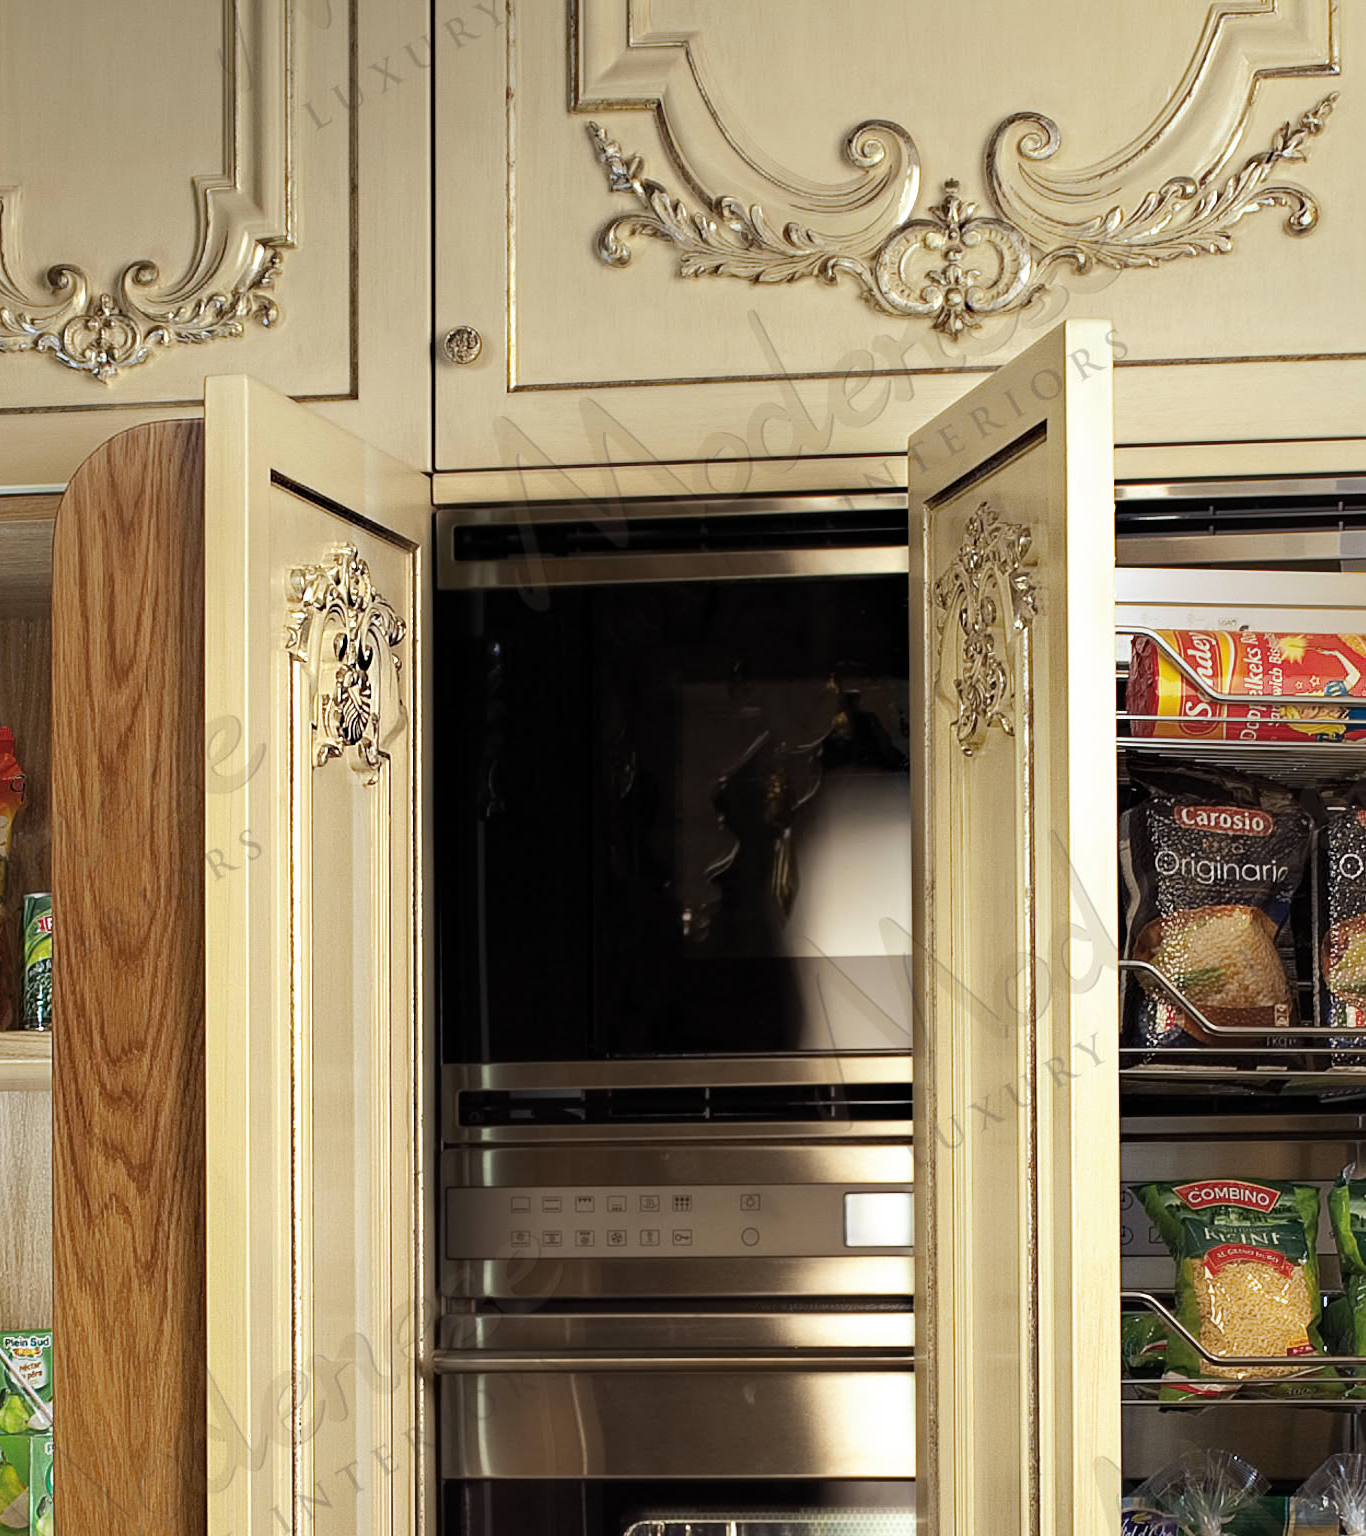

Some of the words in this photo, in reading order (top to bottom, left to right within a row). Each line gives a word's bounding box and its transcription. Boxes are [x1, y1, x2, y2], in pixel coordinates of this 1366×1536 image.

[1185, 631, 1218, 719] Sndey
[1179, 807, 1267, 833] Carosio
[1187, 1186, 1270, 1207] COMBINO
[30, 1337, 49, 1346] Sud
